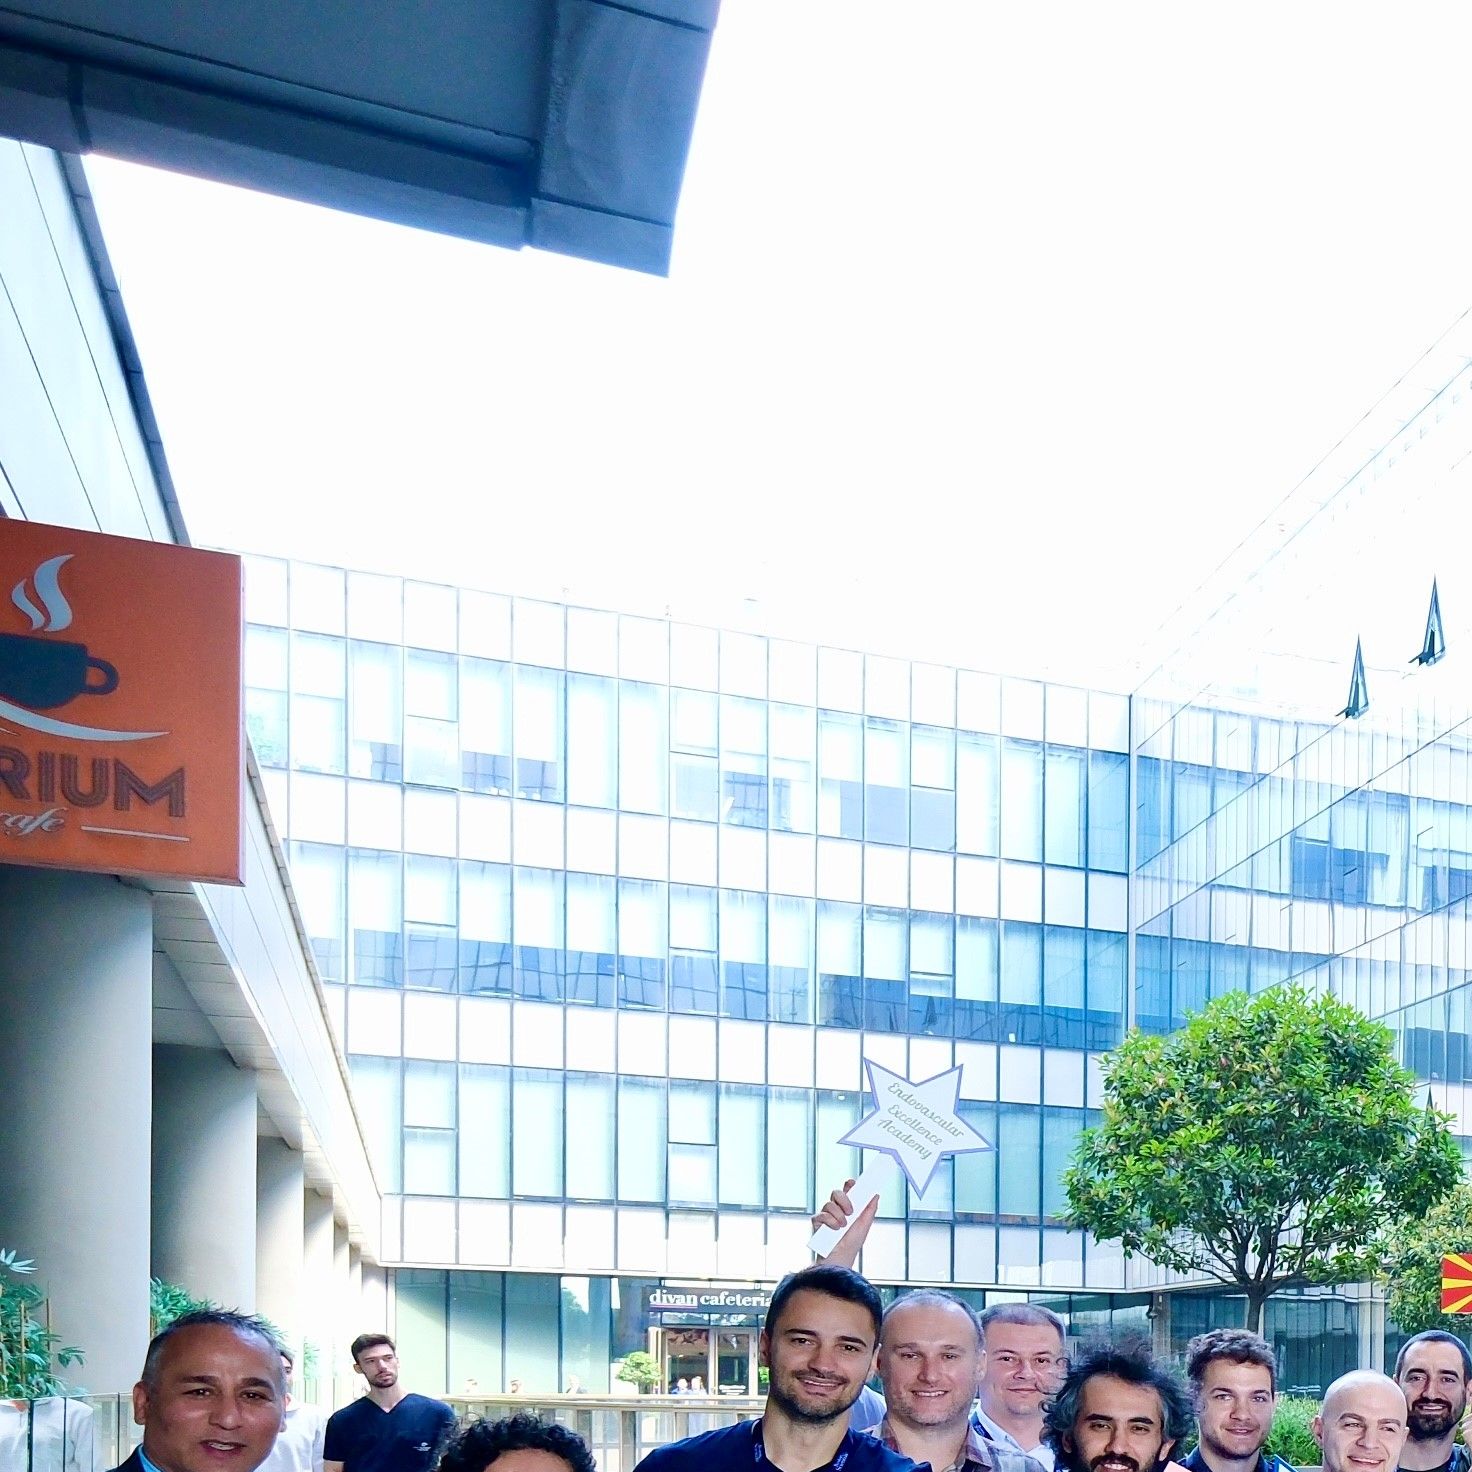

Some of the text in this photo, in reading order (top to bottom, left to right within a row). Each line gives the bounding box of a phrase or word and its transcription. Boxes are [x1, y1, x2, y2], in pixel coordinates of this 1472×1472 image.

[887, 1082, 965, 1138] Endovascular
[888, 1104, 943, 1146] Excellence
[877, 1119, 932, 1160] Academy
[649, 1289, 698, 1306] divan
